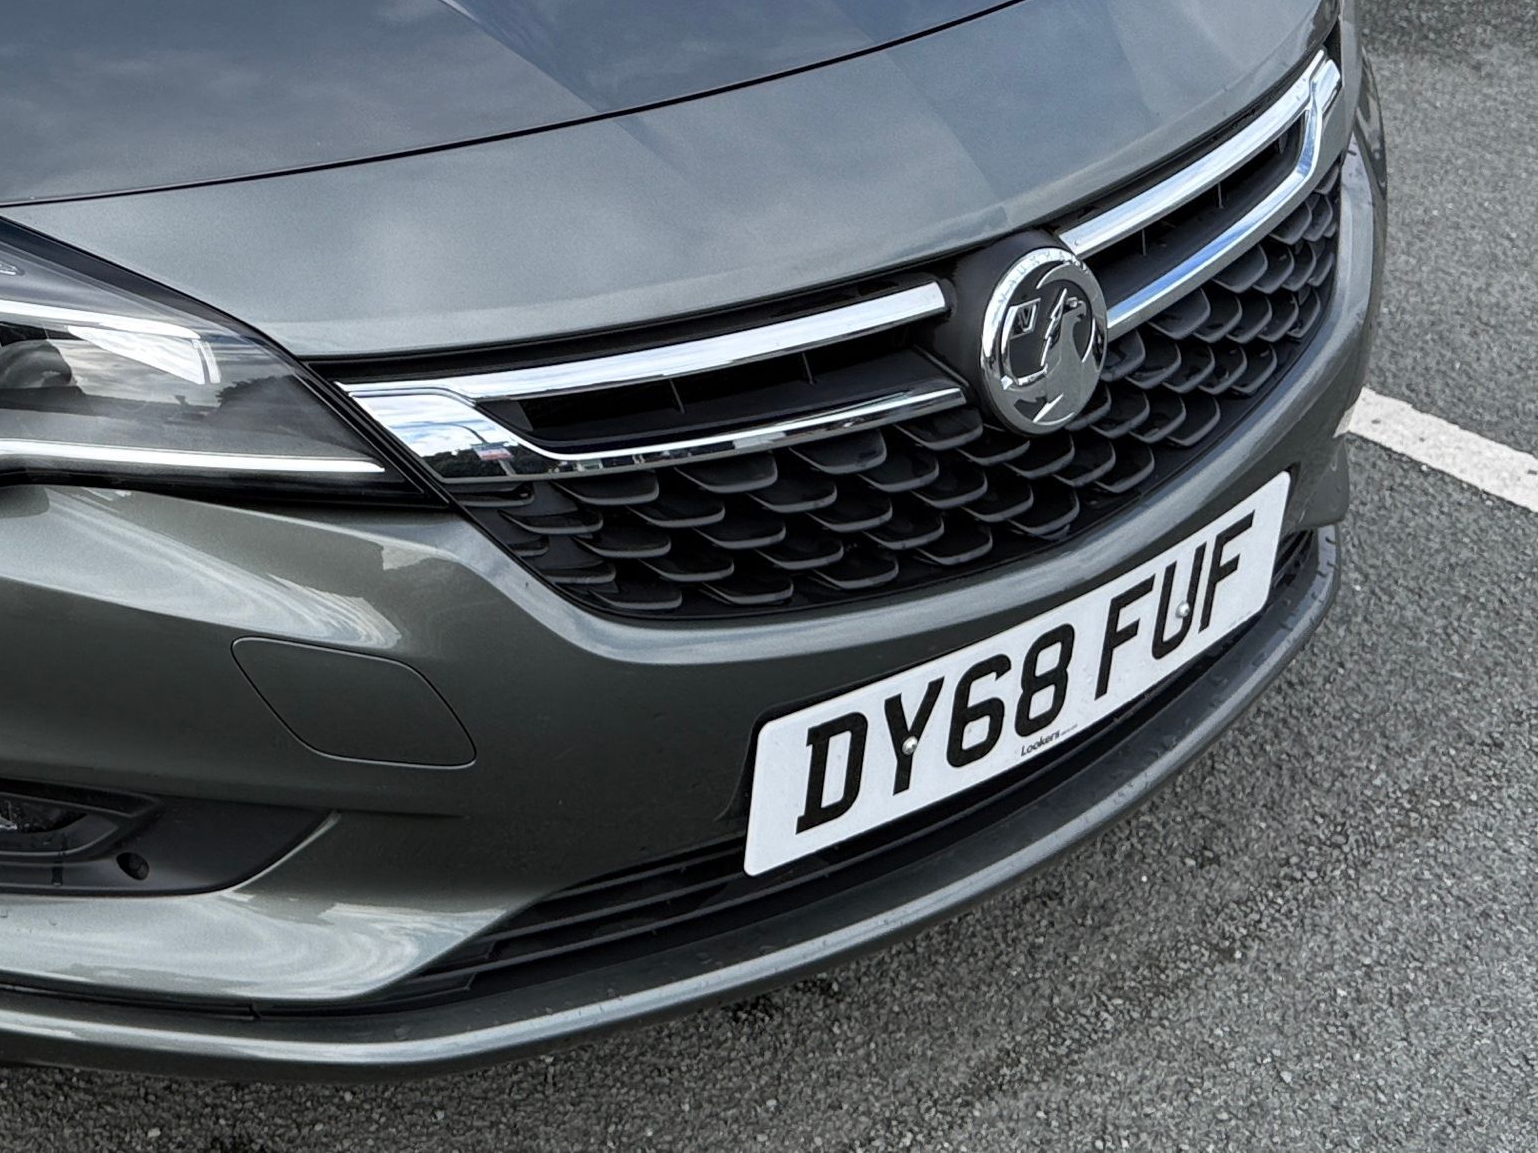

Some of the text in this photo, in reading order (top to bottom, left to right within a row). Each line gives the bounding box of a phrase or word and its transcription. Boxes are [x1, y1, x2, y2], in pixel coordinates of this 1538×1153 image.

[795, 511, 1255, 835] DY68 FUF
[1021, 730, 1060, 757] Lookers
